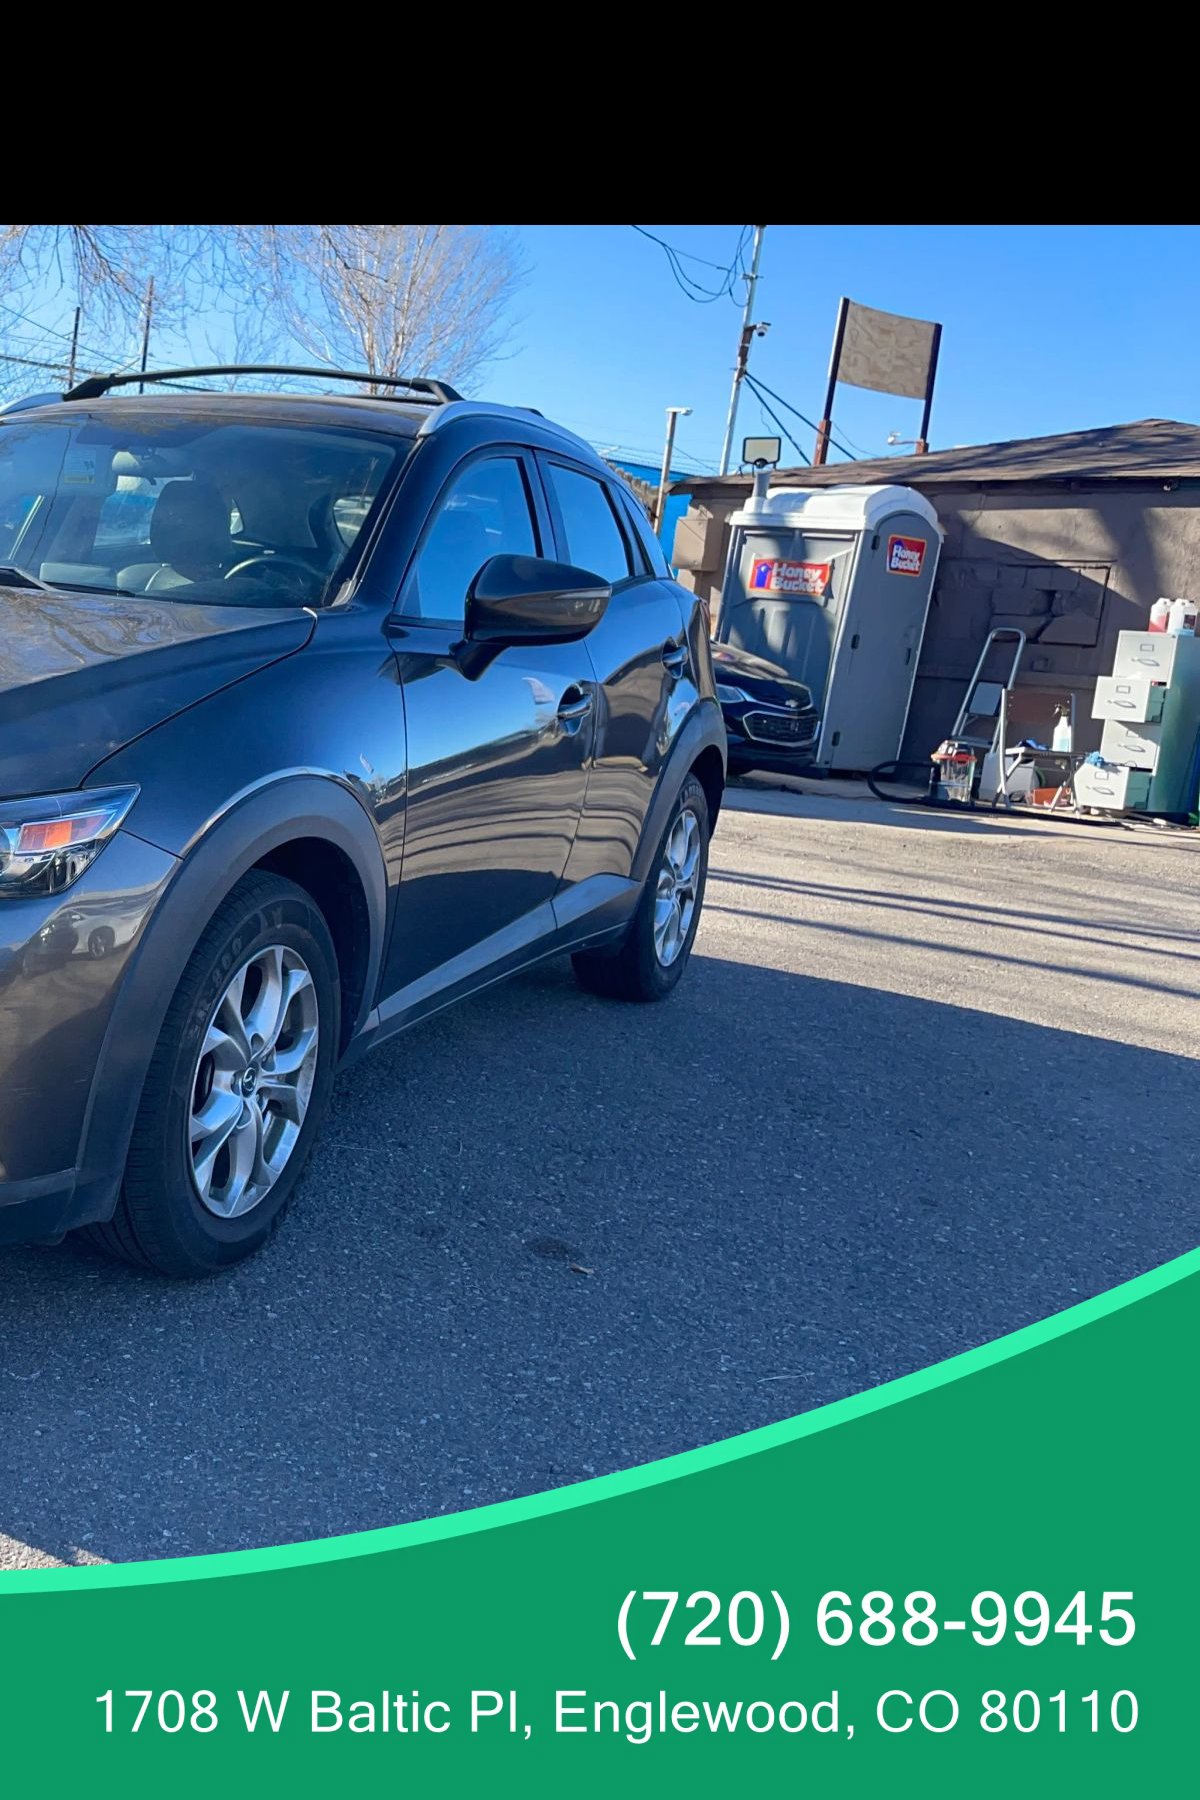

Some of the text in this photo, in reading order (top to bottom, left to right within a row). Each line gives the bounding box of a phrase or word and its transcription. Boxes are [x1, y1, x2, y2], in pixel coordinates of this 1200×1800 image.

[893, 544, 920, 562] Honey
[772, 562, 823, 582] Honey
[891, 557, 920, 571] Bucket
[770, 577, 826, 594] Bucket
